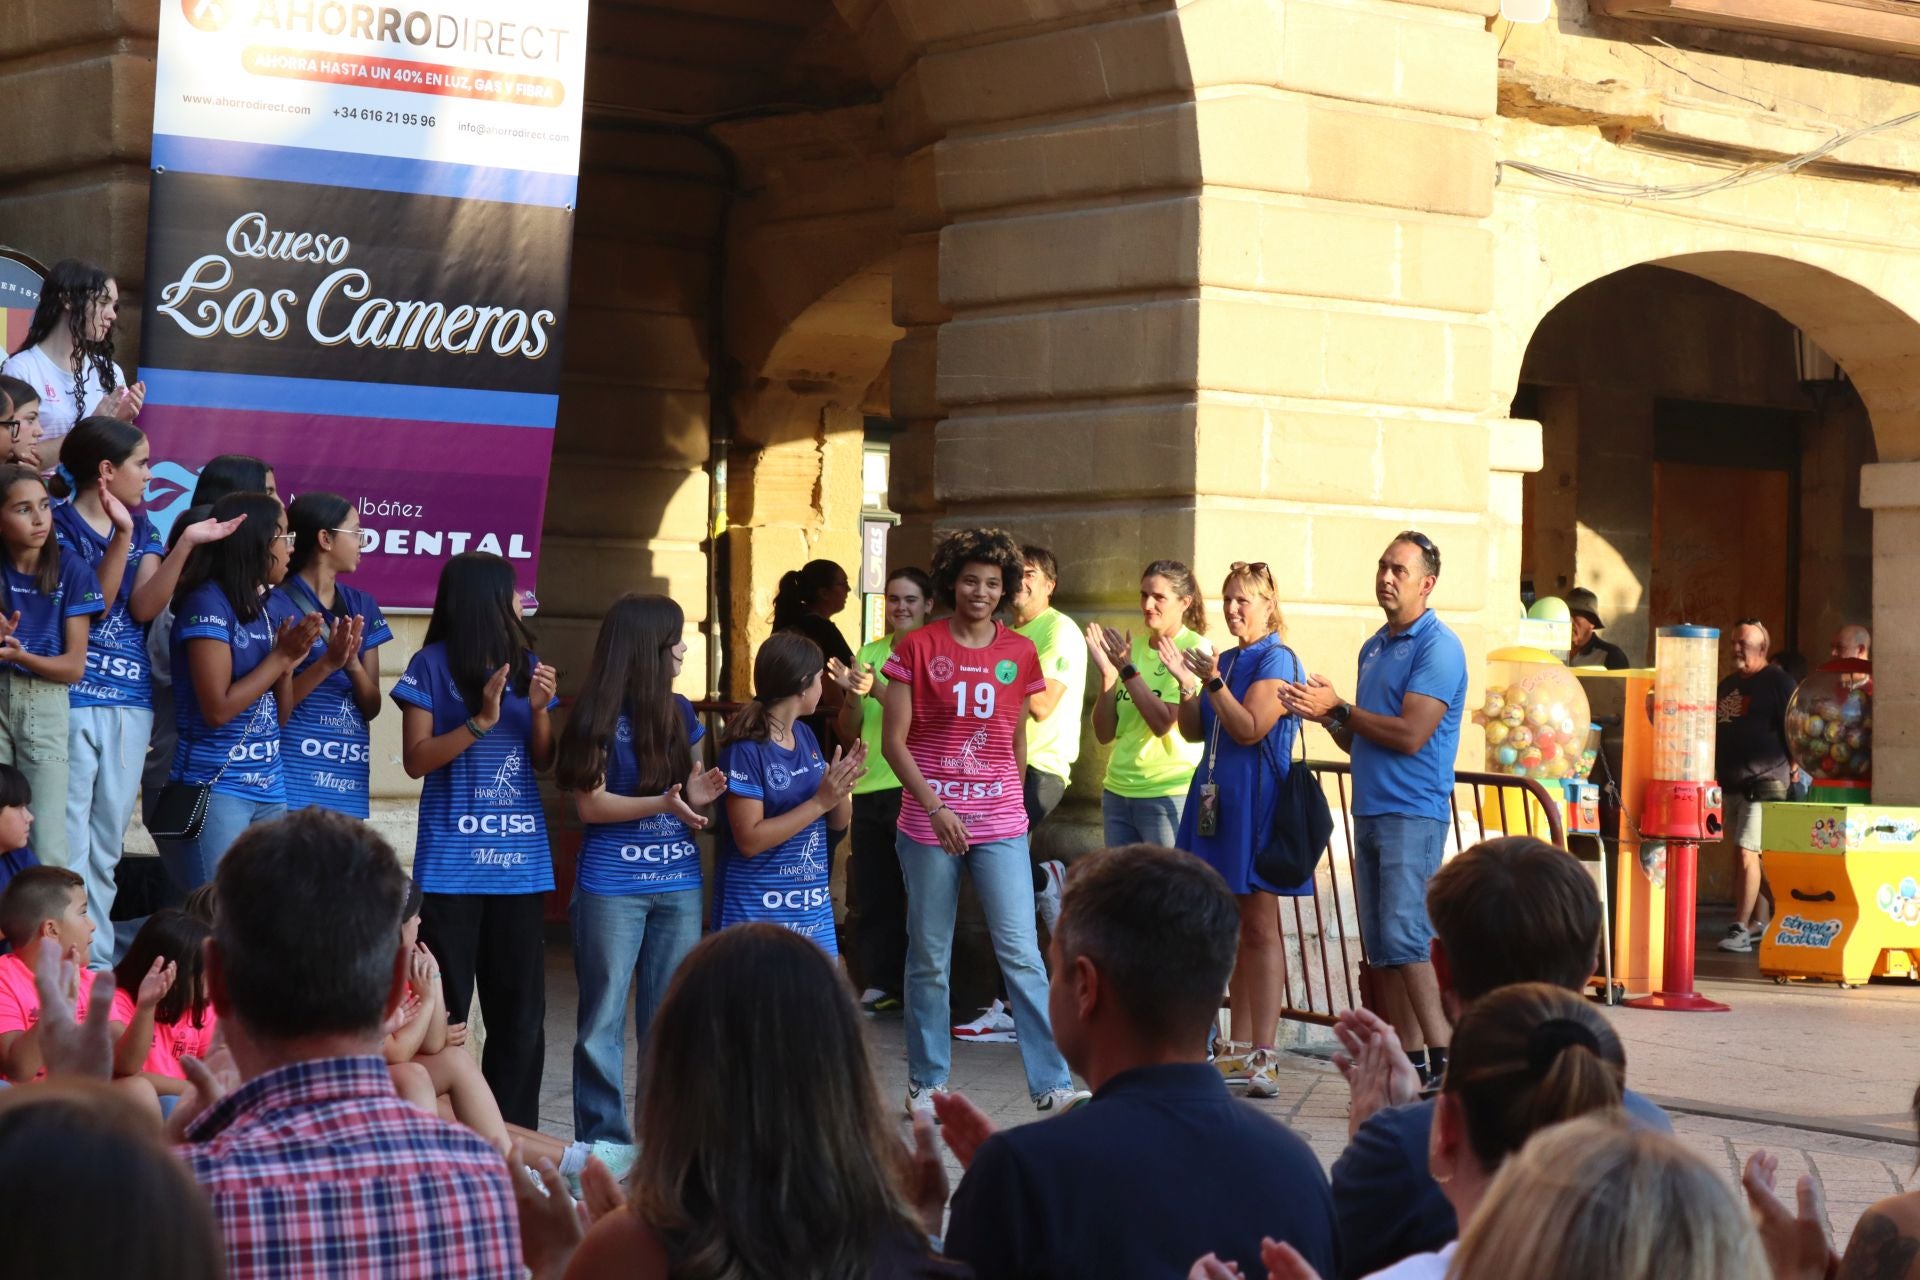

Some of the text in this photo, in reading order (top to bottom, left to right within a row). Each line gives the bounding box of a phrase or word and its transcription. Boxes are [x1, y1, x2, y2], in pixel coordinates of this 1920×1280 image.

[253, 0, 570, 63] AHORRODIRECT
[255, 54, 554, 100] AHORRA HASTA UN 40% EN LUZ, GAS Y FIBRA
[182, 93, 311, 116] www.ahorrodirect.com
[333, 106, 436, 128] +34 616 21 95 96
[458, 121, 570, 142] info@ahorrodirect.com
[225, 211, 351, 265] Queso
[20, 287, 41, 302] 187
[156, 254, 556, 360] Los Cameros
[358, 496, 424, 519] Ibáñez
[362, 529, 533, 560] DENTAL
[200, 614, 227, 627] La Rioja
[952, 681, 996, 719] 19
[313, 771, 357, 794] Muga
[474, 847, 524, 869] Muga
